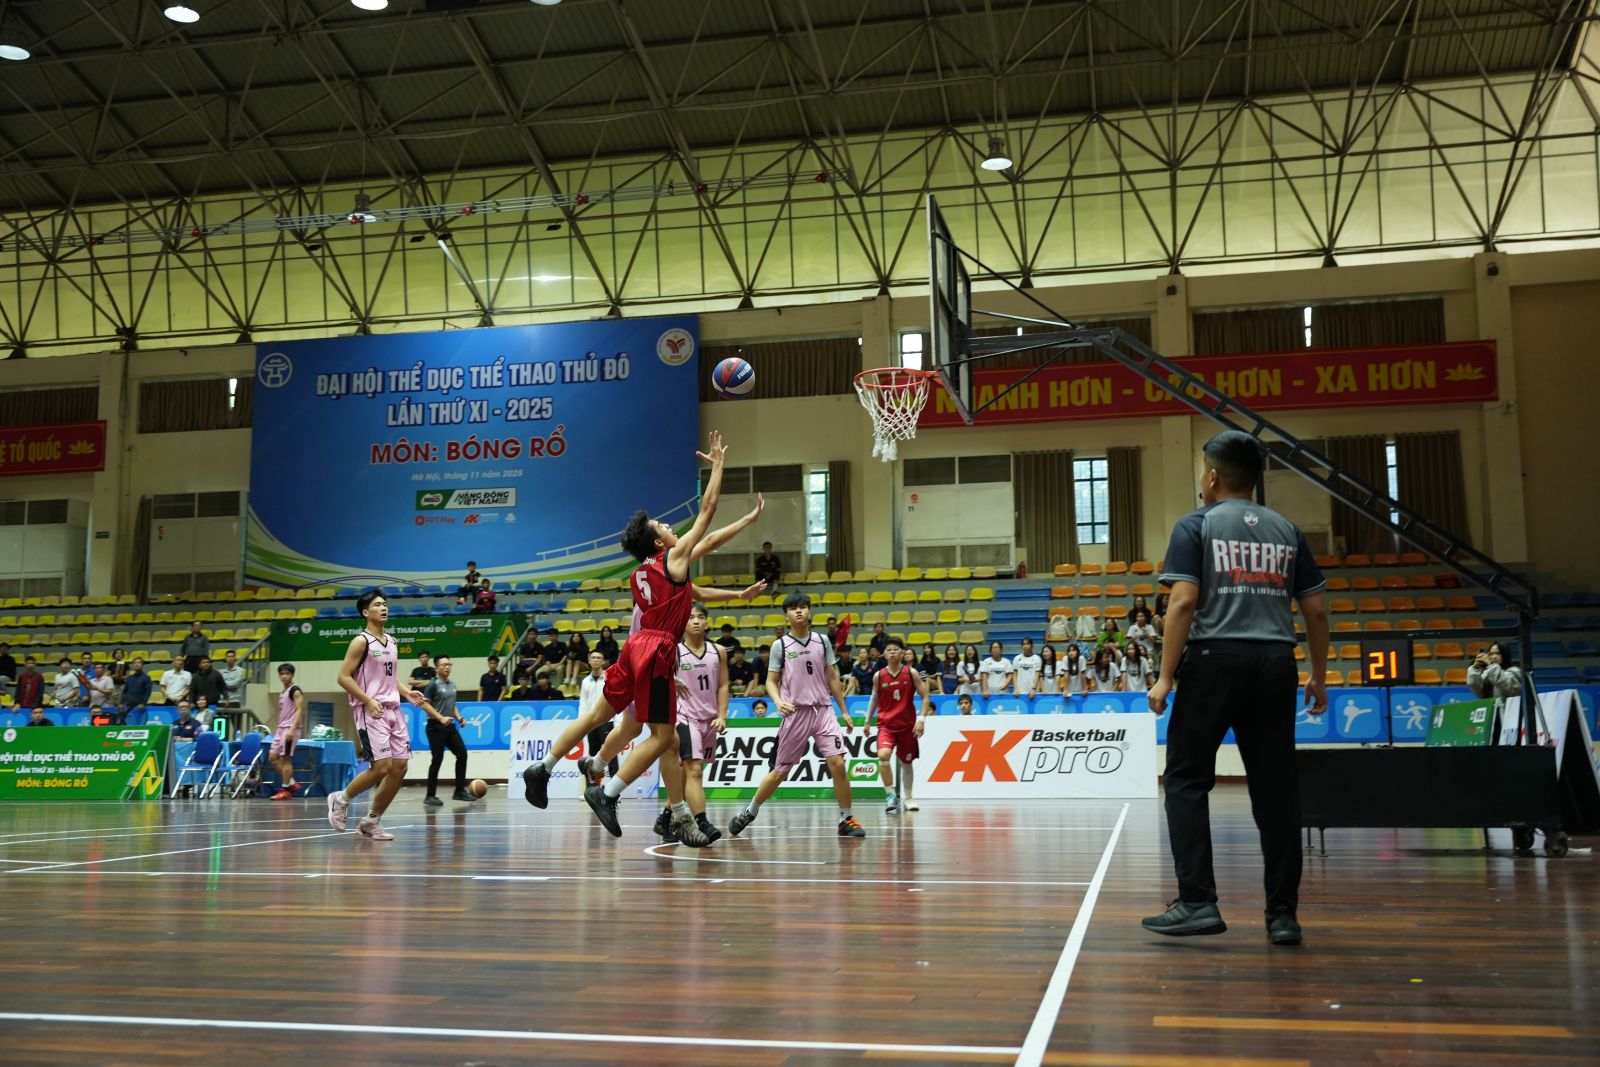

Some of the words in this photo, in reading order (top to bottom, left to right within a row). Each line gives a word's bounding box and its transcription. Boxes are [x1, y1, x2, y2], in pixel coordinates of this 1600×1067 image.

[316, 373, 347, 399] ĐẠI
[352, 368, 383, 398] HỘI
[389, 361, 423, 392] THỂ
[427, 367, 464, 394] DỤC
[470, 356, 505, 388] THỂ
[509, 362, 556, 386] THAO
[562, 352, 598, 382] THỦ
[604, 353, 629, 380] ĐÔ
[936, 381, 1040, 414] NANH
[1049, 376, 1112, 408] HƠN
[1215, 367, 1282, 398] HƠN
[1315, 365, 1358, 393] XA
[1368, 359, 1437, 392] HƠN
[387, 397, 423, 426] LẦN
[429, 398, 465, 424] THỨ
[469, 400, 488, 422] XI
[506, 398, 553, 421] 2025
[28, 433, 62, 464] QUỐC
[370, 437, 438, 464] MÔN:
[447, 434, 521, 462] BÓNG
[529, 425, 567, 458] RỔ
[635, 570, 653, 606] 5
[383, 661, 393, 677] 13
[806, 660, 813, 675] 6
[1368, 651, 1398, 680] 21
[697, 674, 709, 691] 11
[892, 689, 901, 701] 4
[834, 737, 841, 750] 6
[1031, 729, 1126, 742] Basketball
[855, 765, 874, 773] MILO
[928, 730, 1032, 783] AK
[1020, 746, 1124, 782] pro
